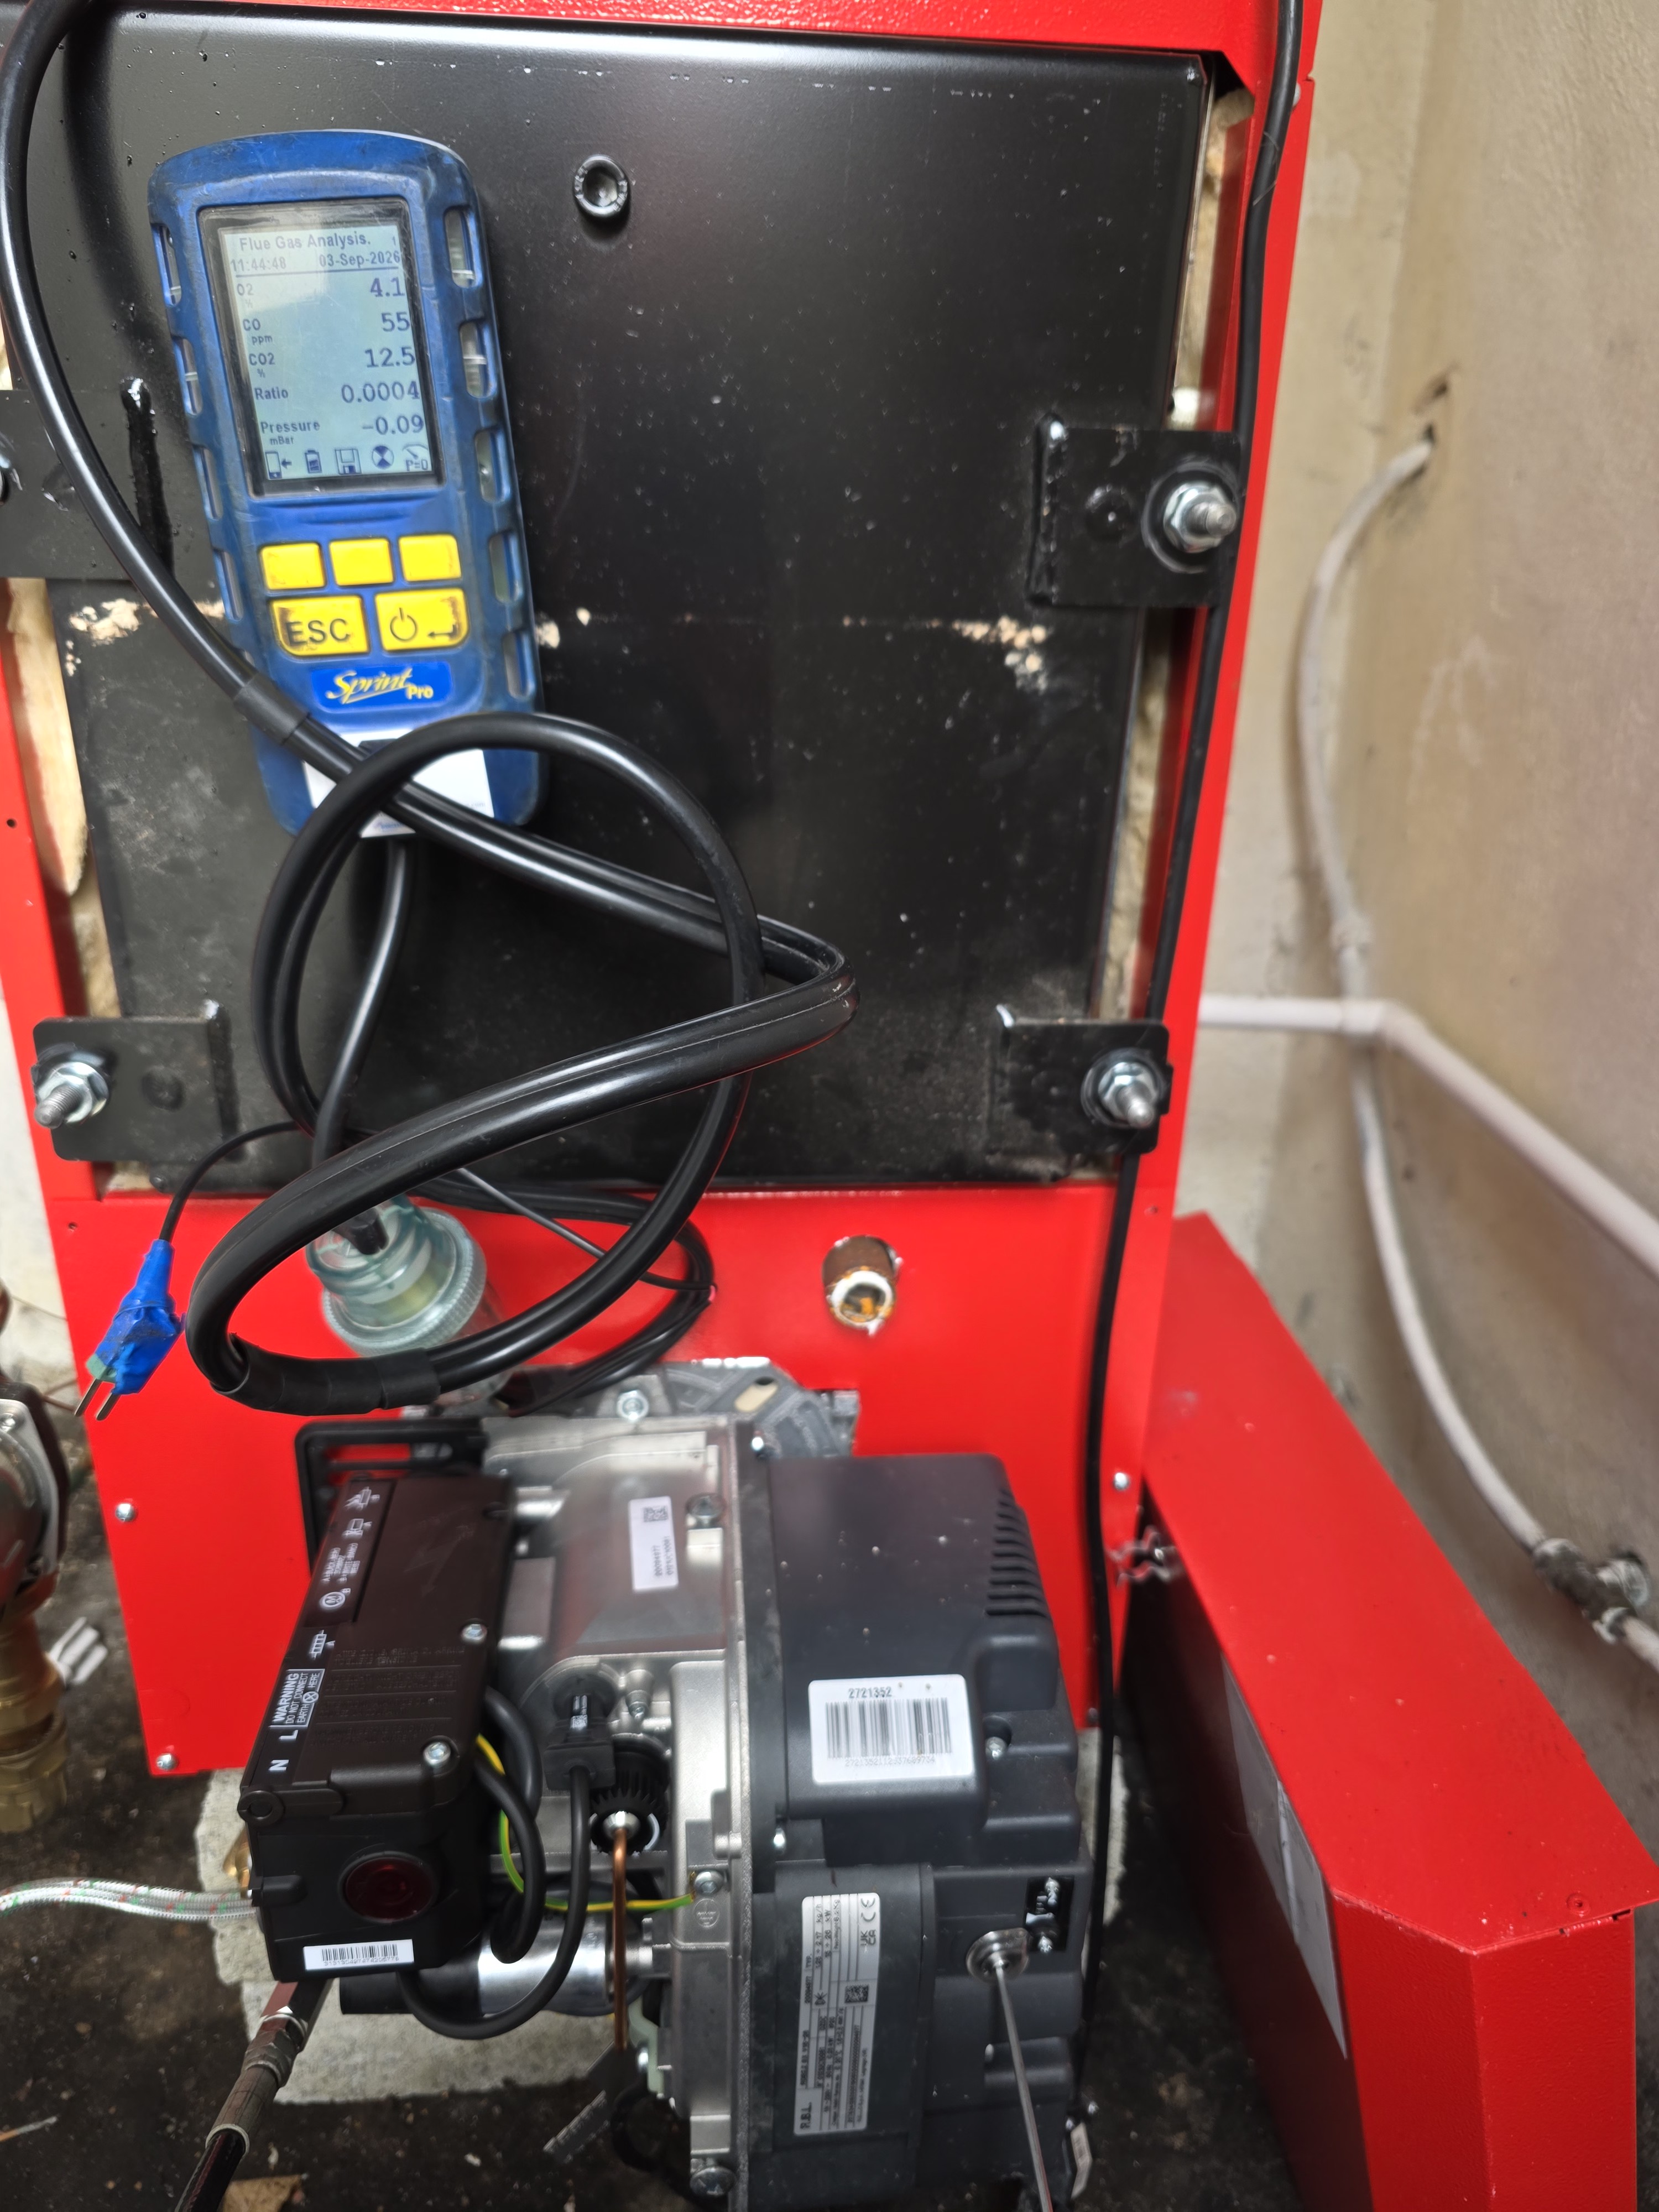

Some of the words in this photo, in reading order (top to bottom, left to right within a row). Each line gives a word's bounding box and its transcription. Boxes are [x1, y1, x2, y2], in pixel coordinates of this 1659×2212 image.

[239, 237, 270, 252] Flue
[275, 236, 302, 249] Gas
[307, 231, 371, 250] Analysis.
[231, 256, 286, 272] 11:44:48
[370, 276, 406, 298] 4.1
[243, 318, 261, 332] CO
[382, 311, 411, 332] 55
[252, 335, 273, 346] ppm
[249, 352, 275, 366] CO2
[364, 346, 416, 368] 12.5
[255, 387, 289, 400] Ratio
[341, 380, 421, 404] 0.0004
[260, 420, 321, 435] Pressure
[362, 414, 425, 436] -0.09
[286, 618, 351, 647] ESC
[326, 667, 413, 705] Sprint
[408, 685, 434, 700] Pro
[293, 1672, 309, 1699] CONNECT
[848, 1687, 893, 1699] 2721352
[272, 1673, 299, 1723] WARNING
[289, 1700, 300, 1713] NOT
[296, 1704, 309, 1724] EARTH
[307, 1672, 321, 1688] HERE
[285, 1714, 296, 1724] DO
[279, 1730, 299, 1741] L
[268, 1759, 289, 1772] N
